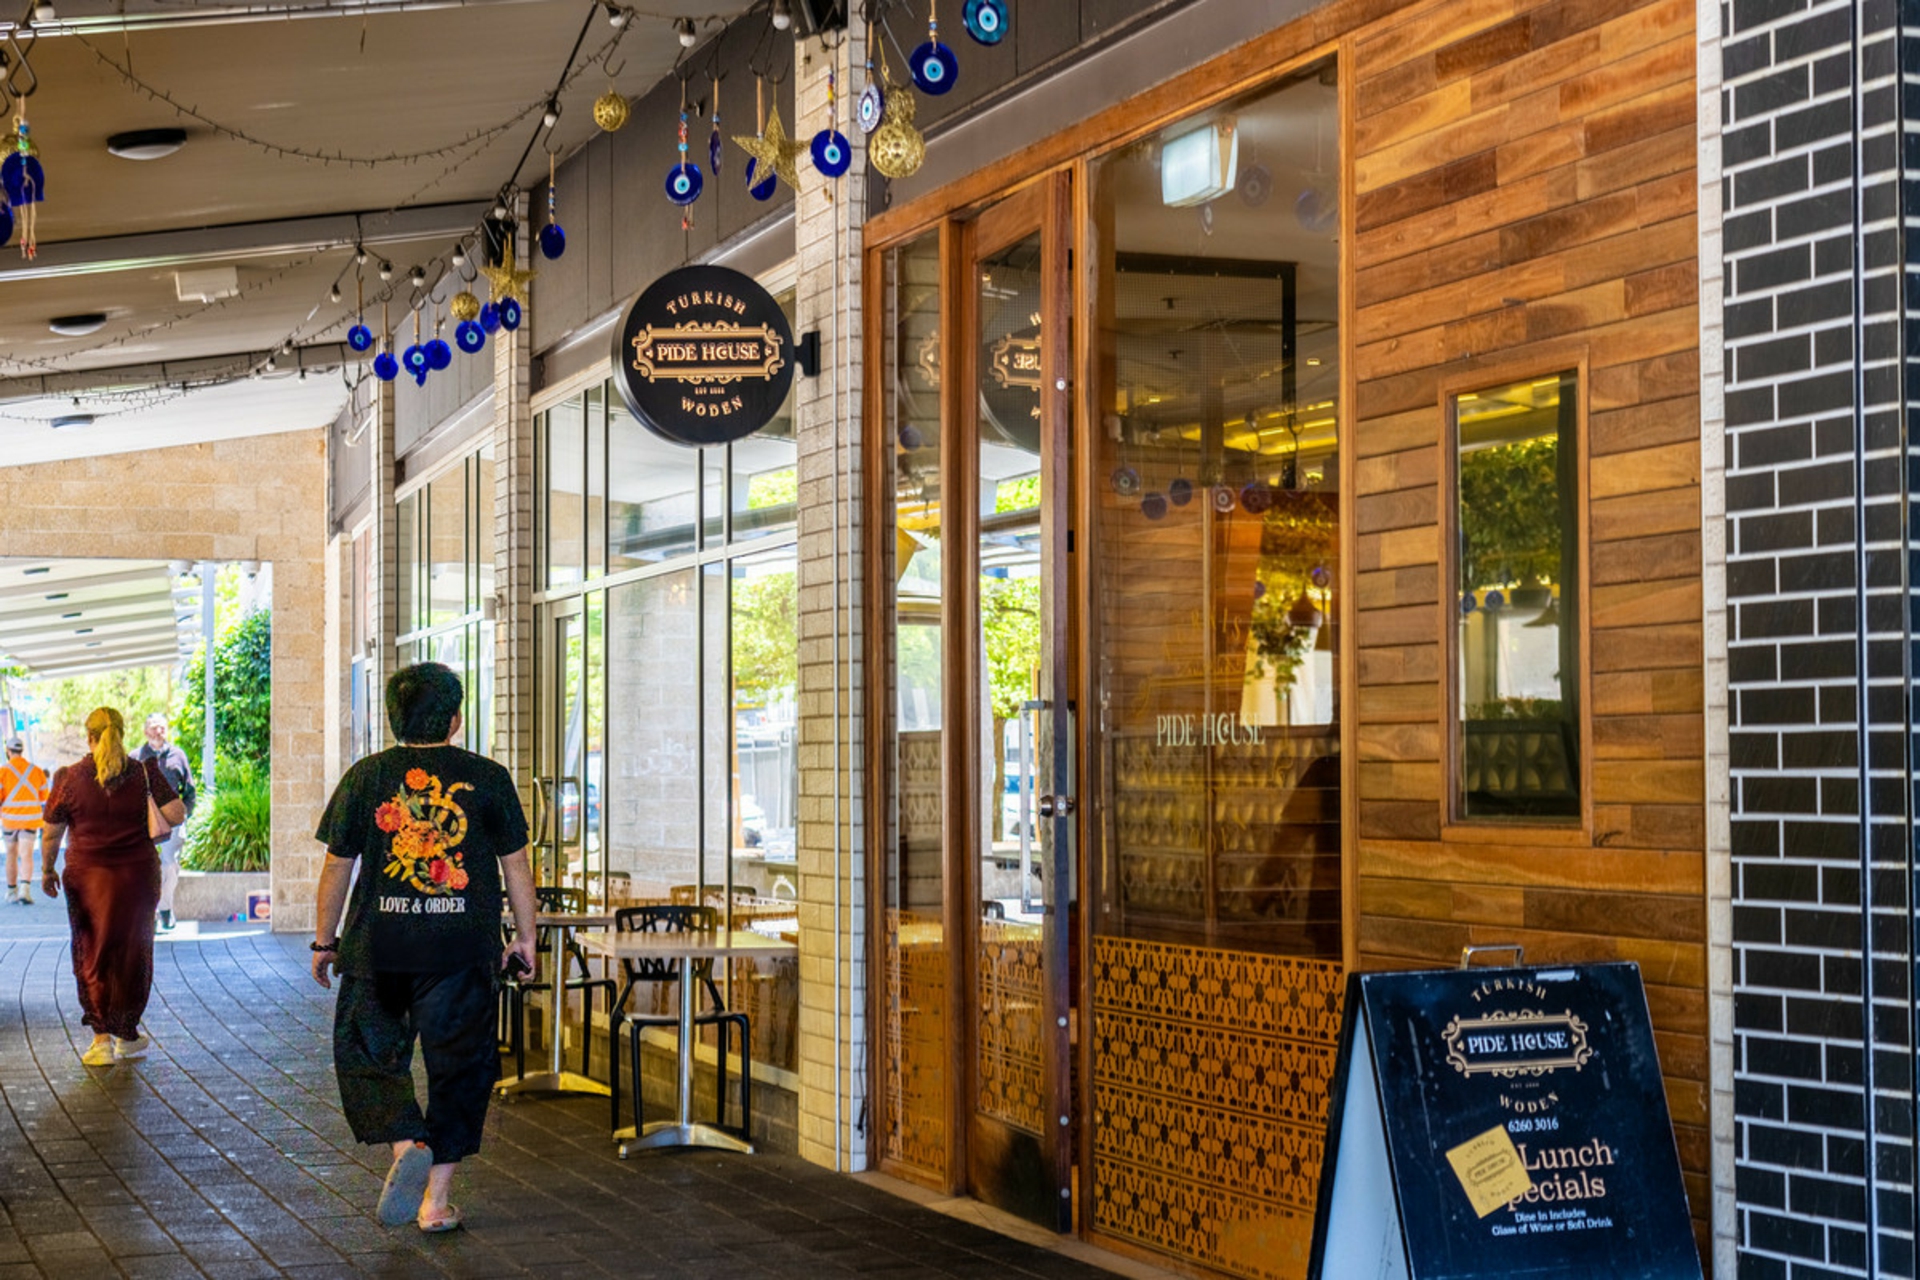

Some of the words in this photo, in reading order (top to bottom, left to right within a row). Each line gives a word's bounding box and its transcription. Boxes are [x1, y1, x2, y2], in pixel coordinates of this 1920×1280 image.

[666, 291, 746, 315] TURKISH
[657, 342, 698, 361] PIDE
[702, 342, 760, 361] HOUSE
[681, 395, 743, 417] WODEN
[1157, 714, 1196, 747] PIDE
[1202, 712, 1266, 746] HOUSE
[379, 896, 410, 914] LOVE
[411, 898, 422, 914] &
[425, 897, 466, 914] ORDER
[1471, 977, 1546, 1002] TURKISH
[1467, 1033, 1508, 1054] PIDE
[1511, 1030, 1569, 1052] HOUSE
[1500, 1091, 1559, 1113] WODEN
[1508, 1119, 1533, 1132] 6260
[1534, 1116, 1559, 1132] 3016
[1517, 1138, 1615, 1170] Lunch
[1507, 1170, 1606, 1211] pecials
[1491, 1224, 1518, 1236] Glass
[1518, 1222, 1528, 1234] of
[1529, 1221, 1554, 1233] Wine
[1555, 1222, 1565, 1231] or
[1566, 1218, 1587, 1230] Soft
[1586, 1215, 1614, 1228] Drink
[1514, 1211, 1537, 1223] Dine
[1549, 1207, 1587, 1220] Includes
